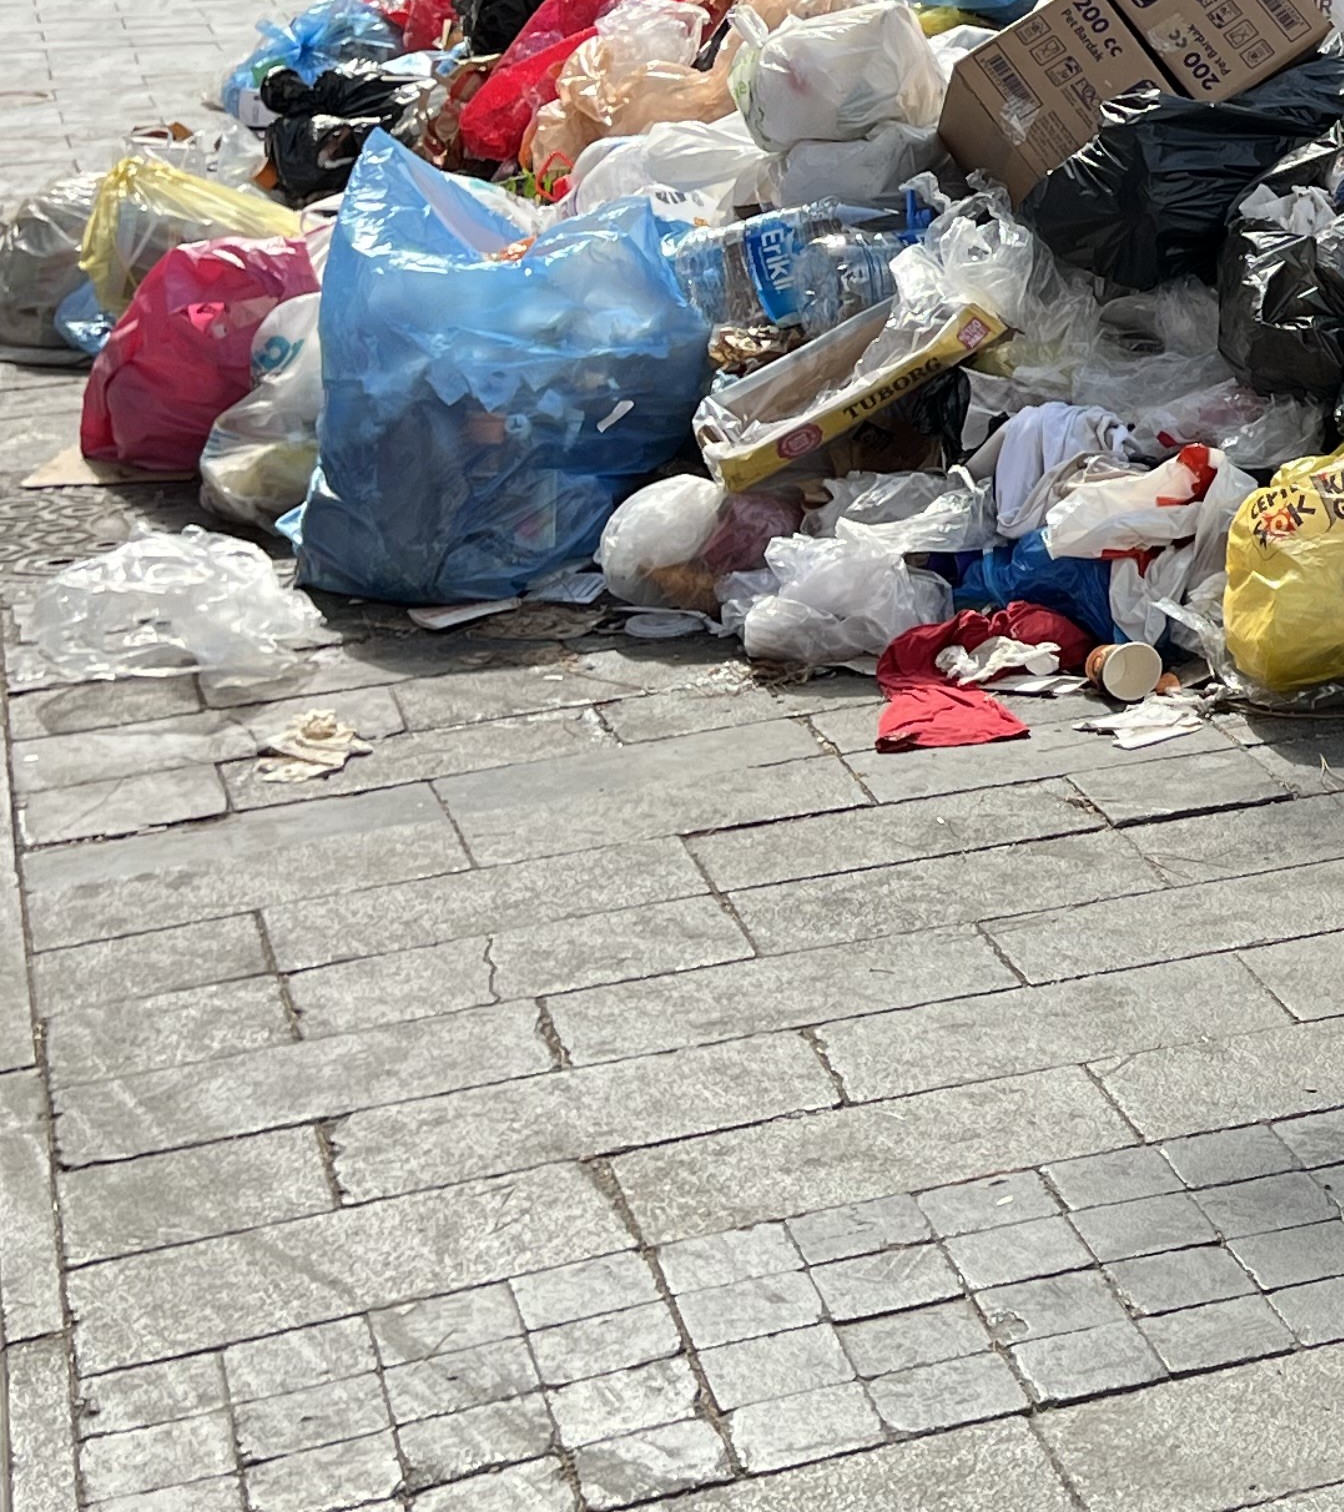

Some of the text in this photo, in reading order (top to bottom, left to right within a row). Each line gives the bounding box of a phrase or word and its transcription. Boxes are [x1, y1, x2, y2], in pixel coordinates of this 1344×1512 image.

[1061, 8, 1105, 62] Pet Bardak
[1104, 37, 1123, 57] cc
[1168, 29, 1221, 91] 200 cc
[1188, 23, 1217, 58] Bardak
[842, 357, 942, 420] TUBORG
